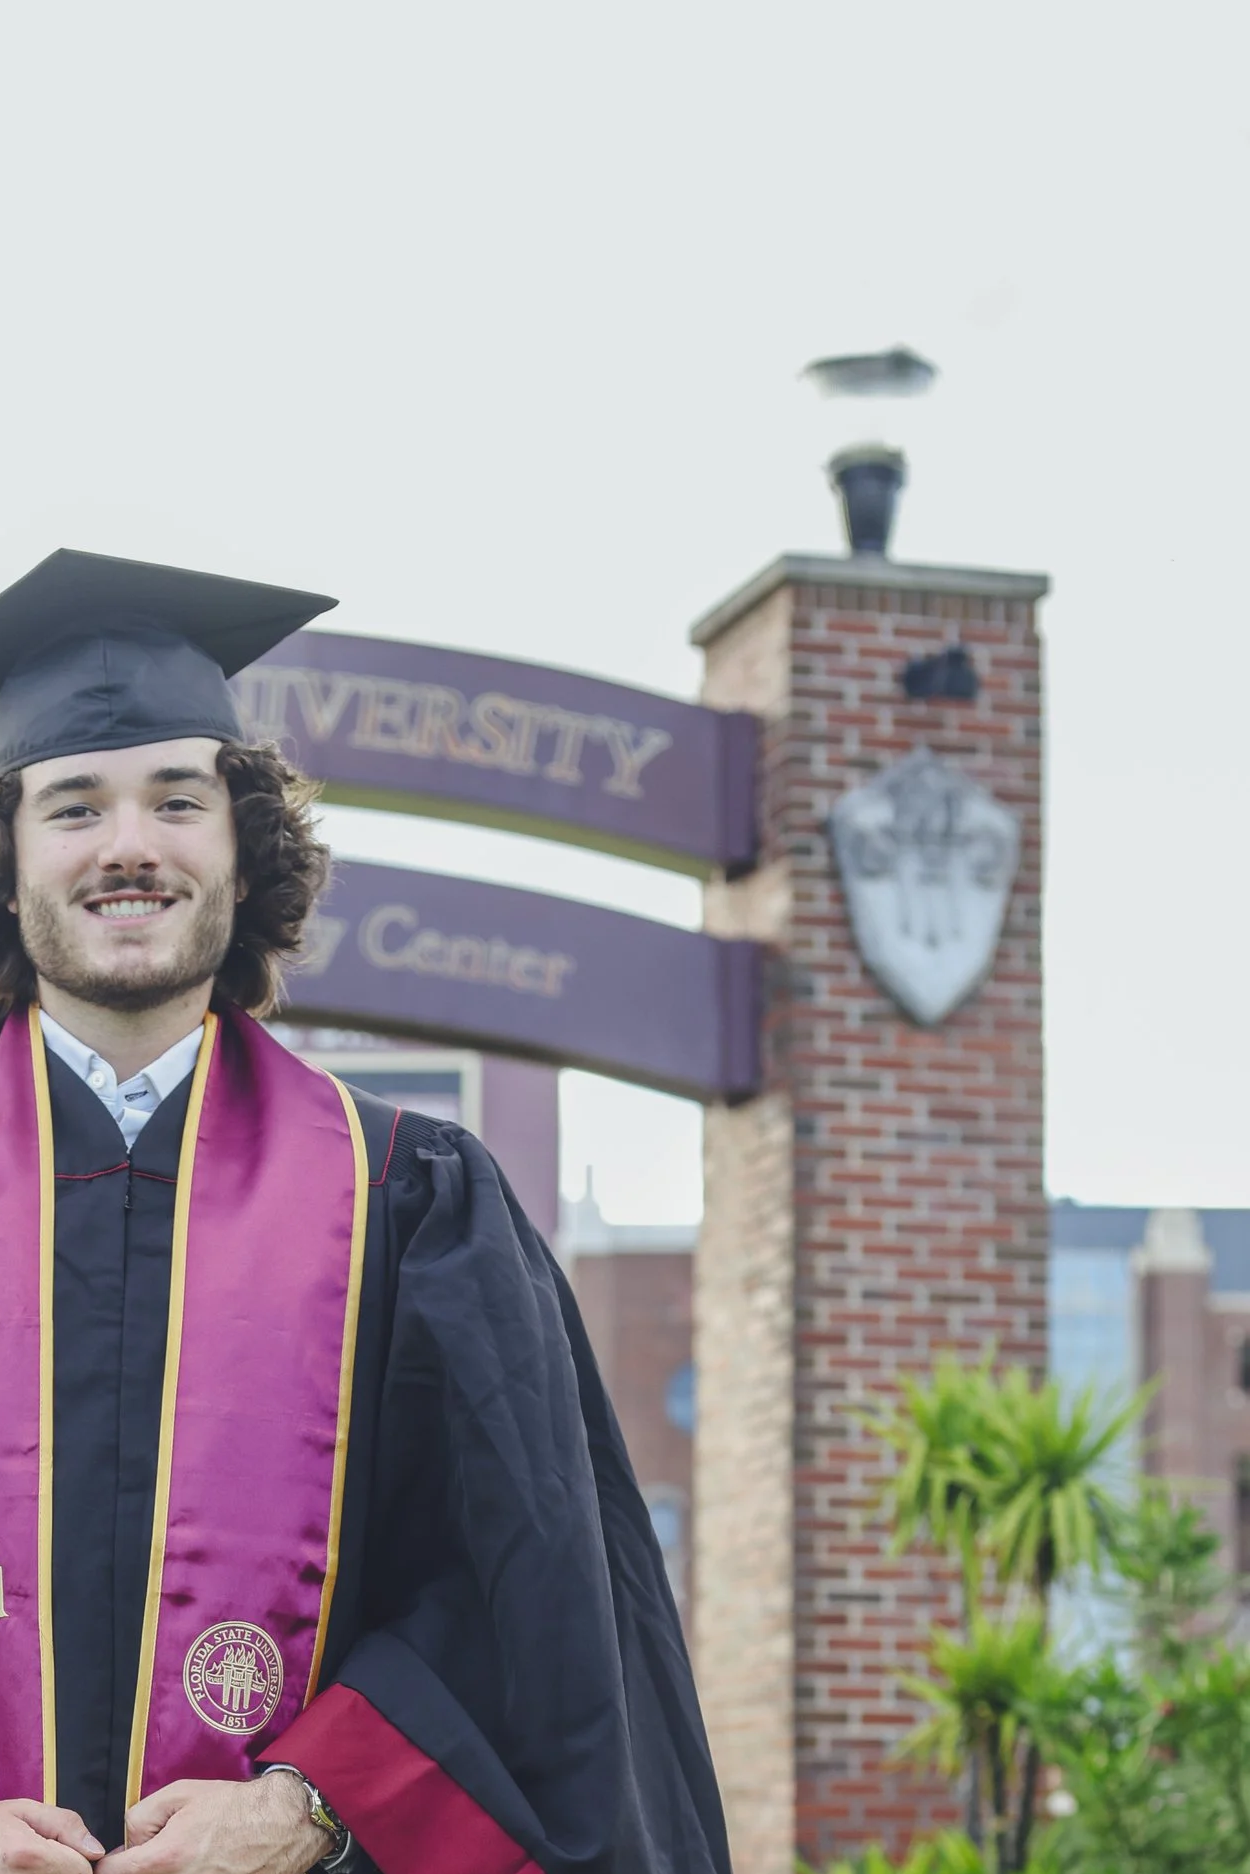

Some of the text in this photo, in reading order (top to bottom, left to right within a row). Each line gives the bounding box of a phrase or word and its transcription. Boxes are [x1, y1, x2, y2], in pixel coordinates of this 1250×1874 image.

[236, 665, 672, 798] IVERSITY
[358, 904, 576, 997] Center
[191, 1628, 278, 1714] FLORIDA STATE UNIVERSITY
[221, 1714, 247, 1728] 1851
